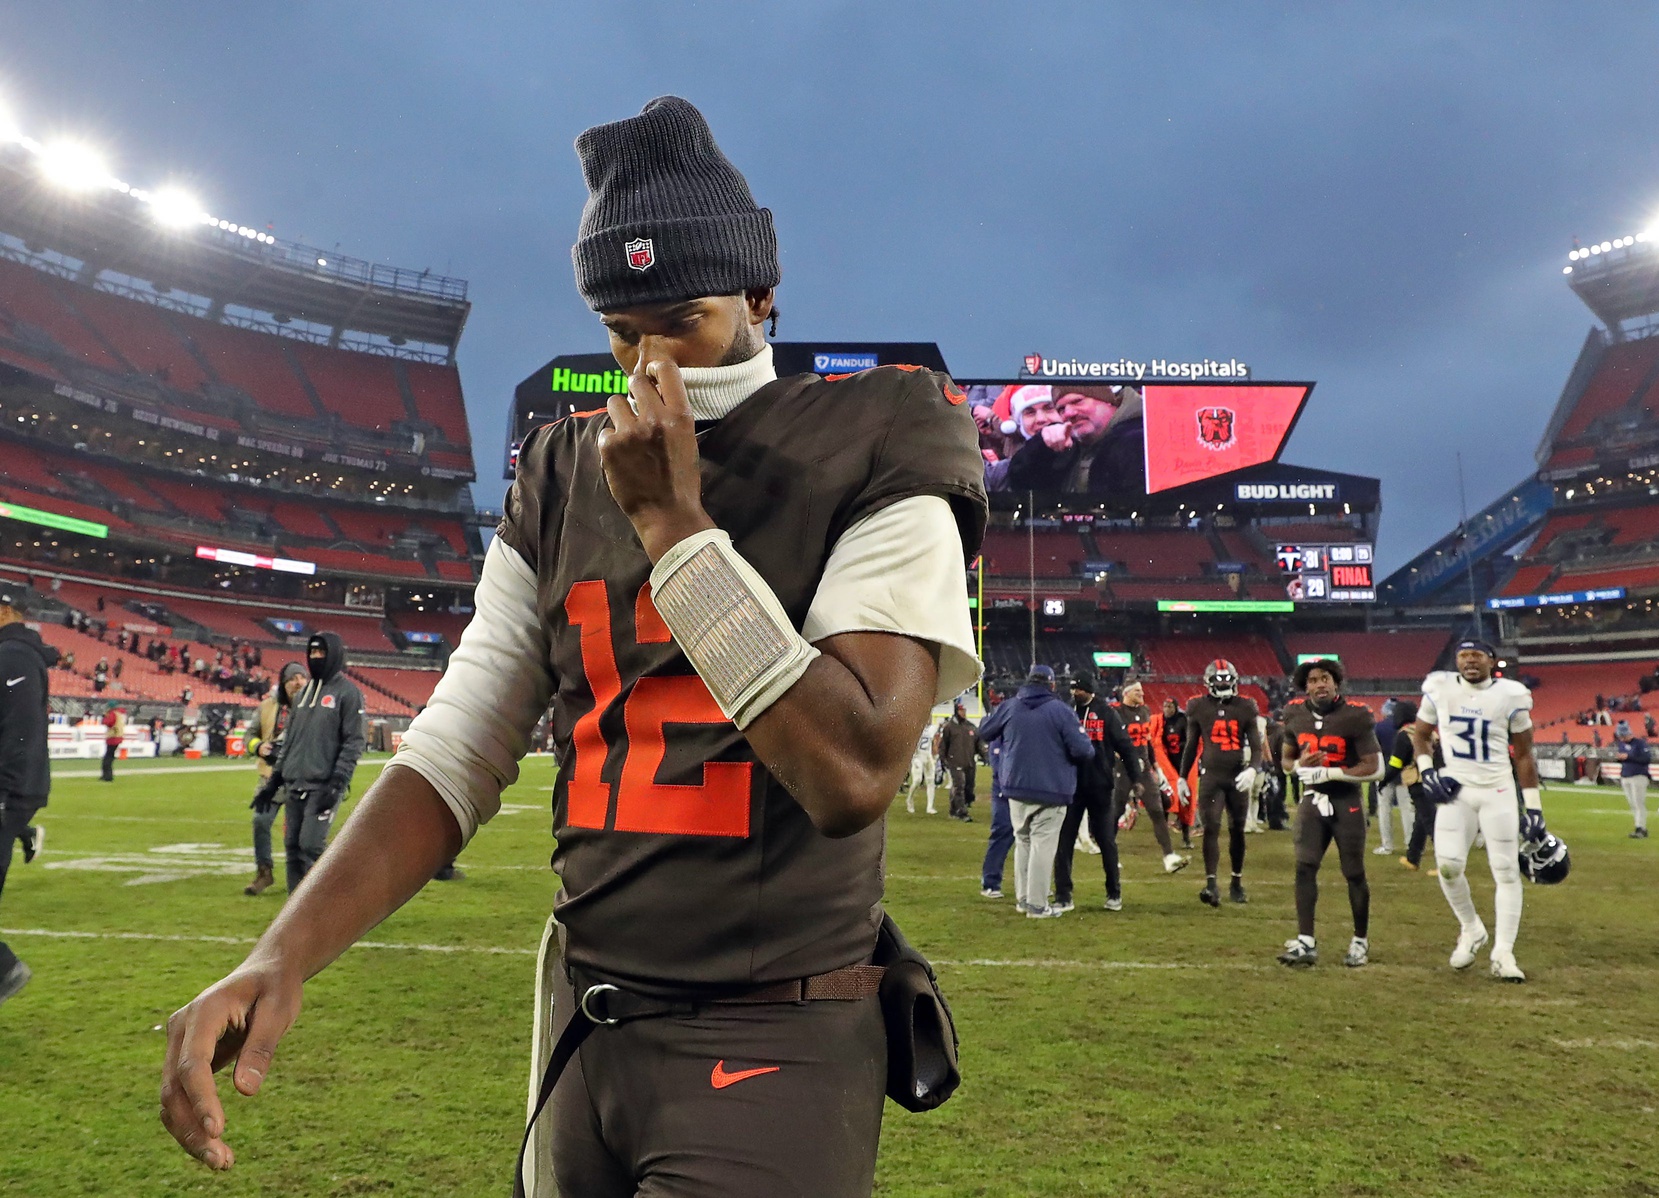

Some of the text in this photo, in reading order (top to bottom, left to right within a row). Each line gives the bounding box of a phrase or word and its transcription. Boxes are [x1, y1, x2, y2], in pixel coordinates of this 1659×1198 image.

[830, 358, 877, 367] FANDUEL
[1042, 358, 1247, 380] University Hospitals
[1237, 484, 1336, 499] BUD LIGHT
[1332, 566, 1371, 586] FINAL
[564, 579, 754, 838] 12
[1210, 719, 1240, 751] 41
[1449, 714, 1492, 762] 31
